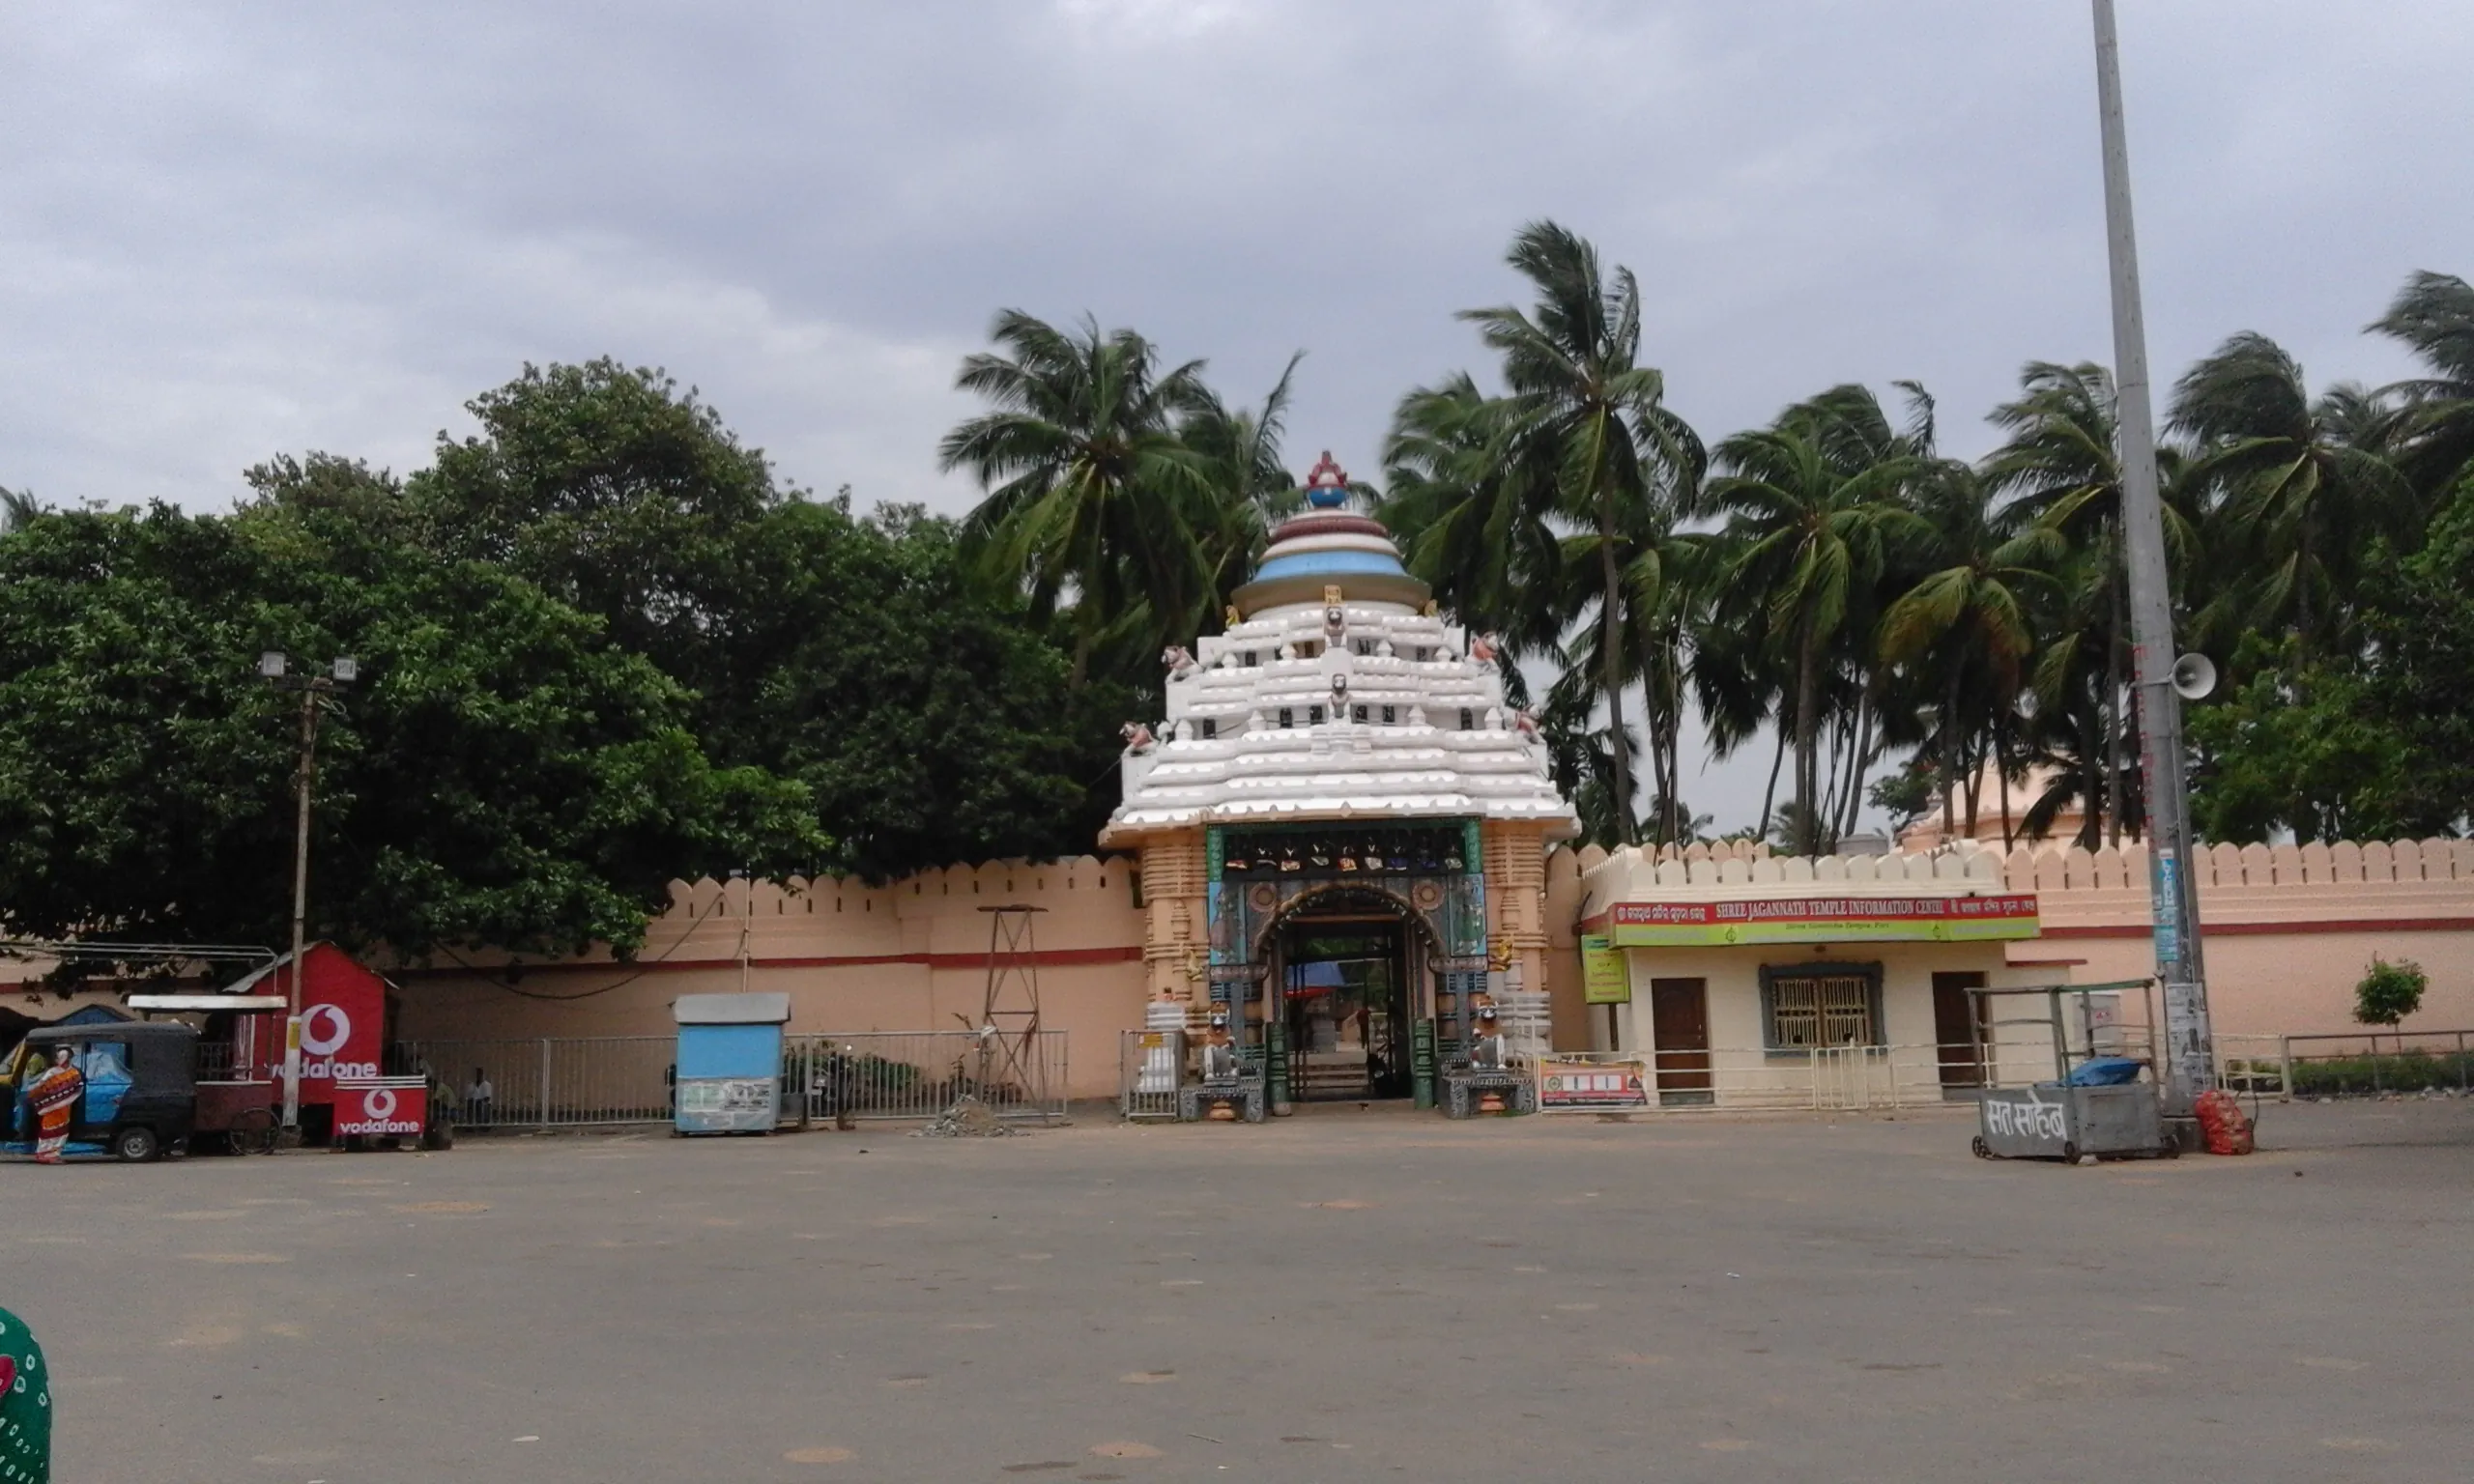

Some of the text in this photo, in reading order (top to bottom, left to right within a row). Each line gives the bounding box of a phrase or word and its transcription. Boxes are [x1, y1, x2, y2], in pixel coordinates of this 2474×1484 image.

[1716, 902, 1747, 918] SHREE
[1747, 900, 1806, 922] JAGANNATH
[1808, 899, 1848, 916] TEMPLE
[1849, 899, 1913, 916] INFORMATION
[339, 1118, 420, 1134] vodafone
[1986, 1099, 2015, 1136] सत
